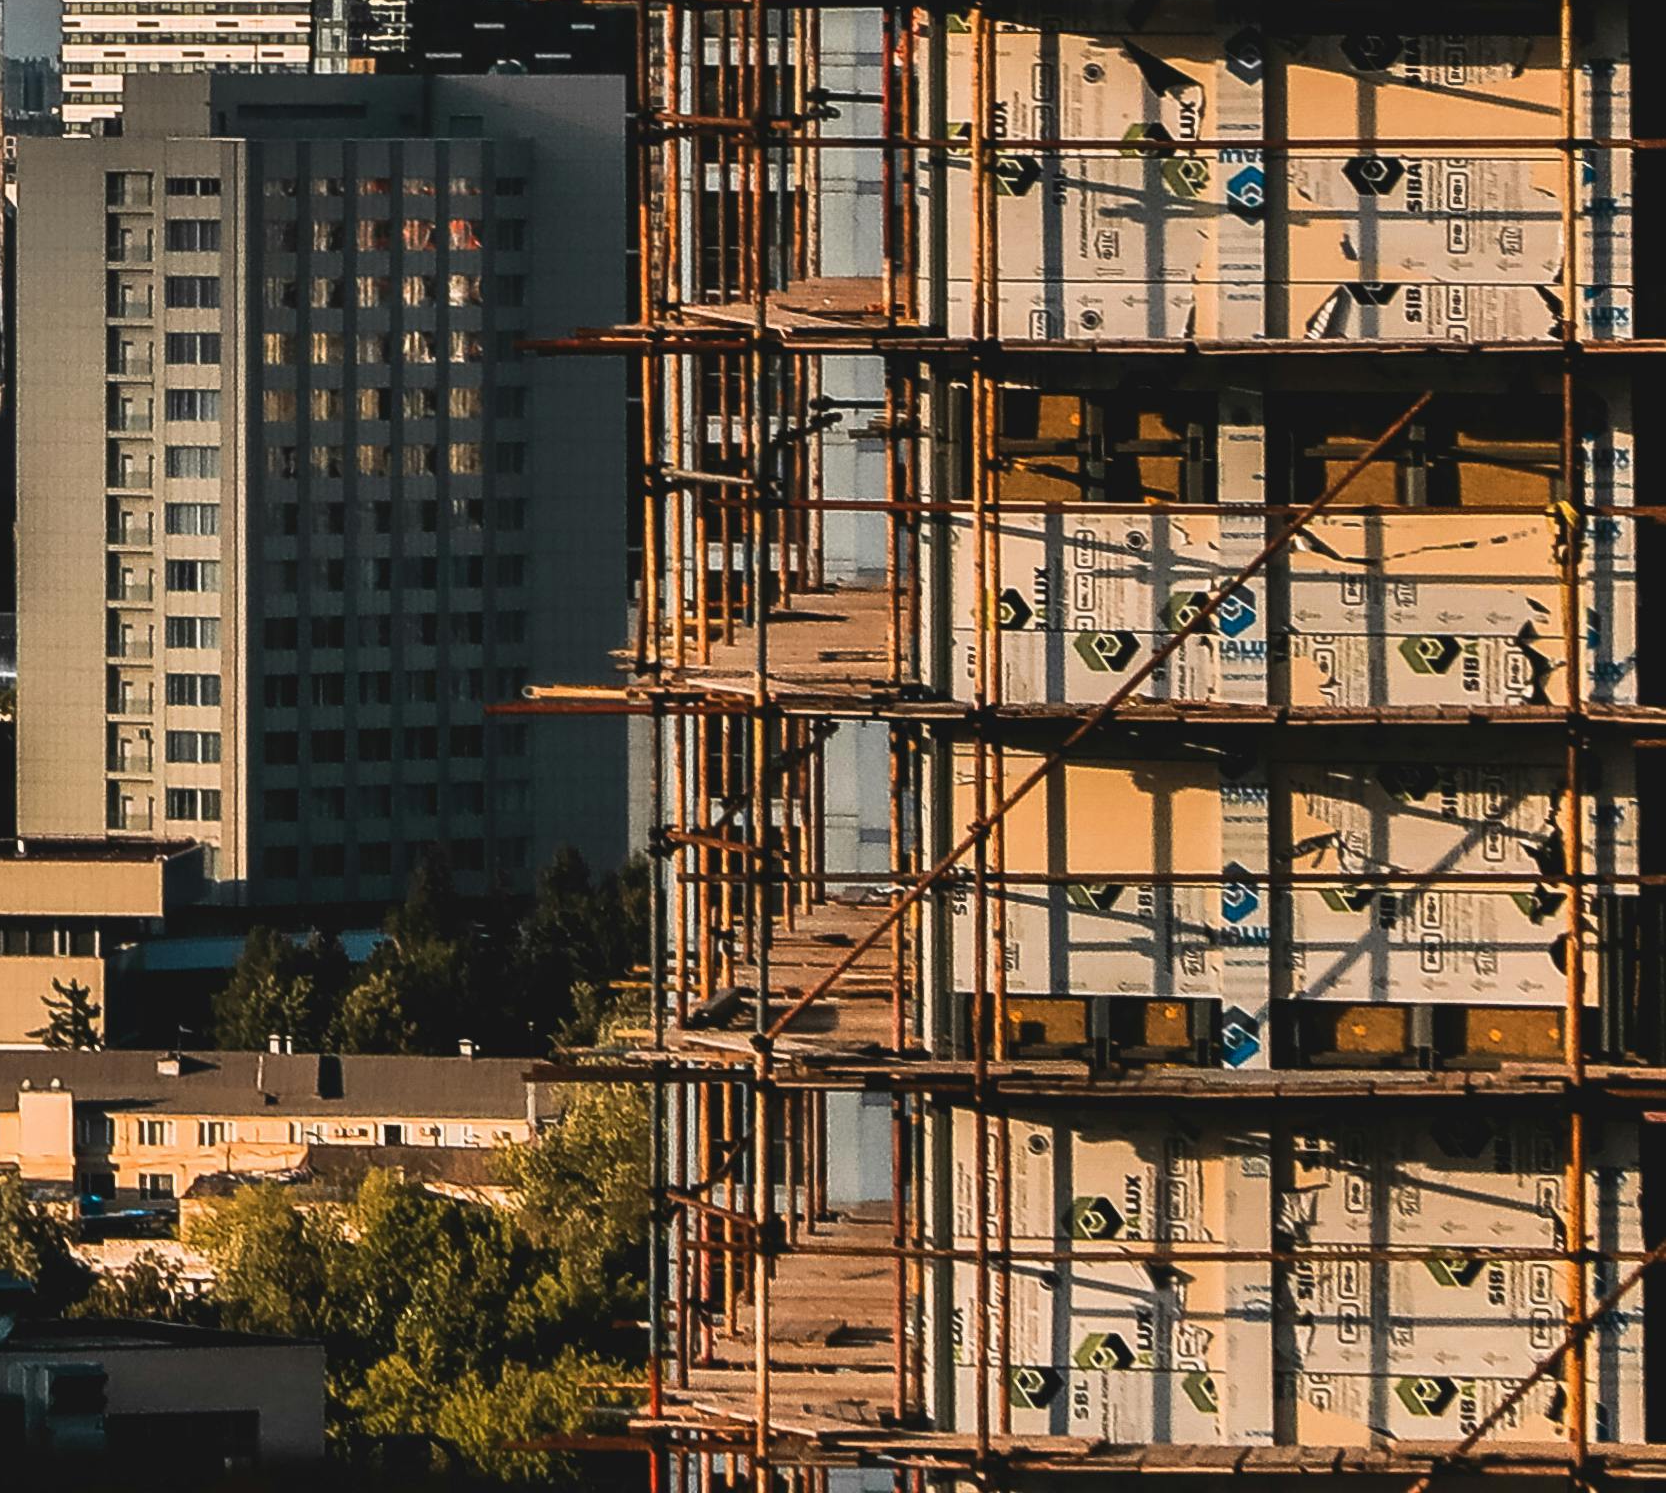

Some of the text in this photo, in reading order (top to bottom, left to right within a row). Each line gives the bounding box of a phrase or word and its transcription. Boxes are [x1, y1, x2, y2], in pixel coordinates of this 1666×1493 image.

[1180, 101, 1196, 139] LUX
[1405, 285, 1421, 323] SIB
[1074, 1380, 1089, 1419] SBL
